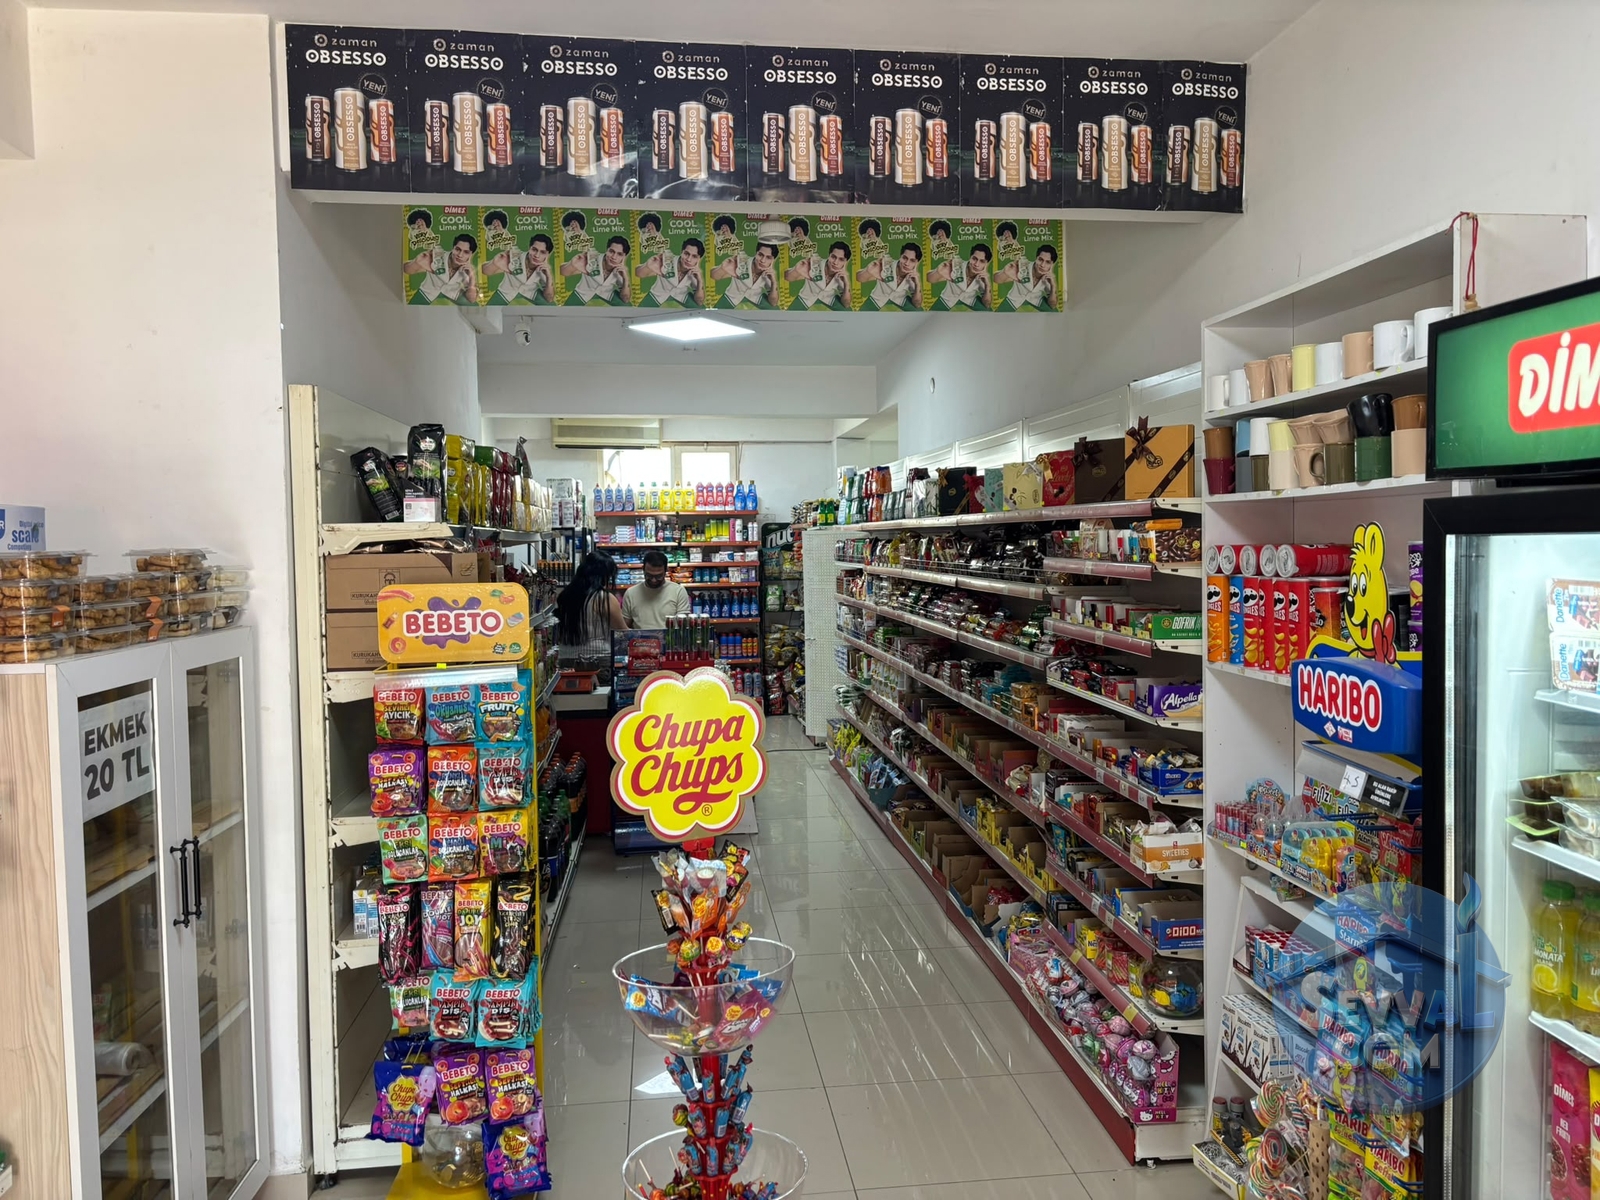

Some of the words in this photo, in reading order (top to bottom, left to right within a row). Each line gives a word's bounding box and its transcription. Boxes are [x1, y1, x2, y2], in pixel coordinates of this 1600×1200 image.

[332, 39, 377, 48] zaman
[450, 42, 494, 52] zaman
[305, 49, 386, 66] OBSESSO
[566, 48, 609, 58] zaman
[678, 54, 720, 63] zaman
[424, 54, 504, 70] OBSESSO
[541, 60, 618, 76] OBSESSO
[787, 58, 828, 66] zaman
[895, 61, 934, 71] zaman
[653, 65, 728, 80] OBSESSO
[763, 69, 836, 84] OBSESSO
[1000, 66, 1038, 74] zaman
[1102, 69, 1141, 78] zaman
[1196, 72, 1232, 82] zaman
[871, 73, 942, 88] OBSESSO
[977, 77, 1046, 92] OBSESSO
[1079, 80, 1148, 95] OBSESSO
[1172, 82, 1238, 99] OBSESSO
[345, 96, 354, 142] OBSESSO
[380, 105, 388, 141] OBSESSO
[432, 107, 440, 142] OBSESSO
[464, 100, 472, 145] OBSESSO
[577, 105, 586, 148] OBSESSO
[659, 115, 667, 150] OBSESSO
[689, 109, 697, 152] OBSESSO
[798, 112, 806, 156] OBSESSO
[1201, 124, 1210, 166] OBSESSO
[440, 216, 470, 224] COOL
[669, 219, 697, 227] COOL
[959, 226, 984, 234] COOL
[1518, 331, 1600, 417] DİM
[1555, 588, 1564, 622] Danette
[405, 611, 501, 633] BEBETO
[1559, 643, 1568, 679] Danette
[378, 693, 416, 701] BEBETO
[432, 691, 470, 702] BEBETO
[482, 692, 519, 701] BEBETO
[1163, 692, 1197, 709] Alpella
[1299, 667, 1377, 729] HARIBO
[480, 703, 519, 713] FRUITY
[84, 710, 148, 756] EKMEK
[634, 713, 745, 756] Chupa
[84, 757, 114, 801] 20
[121, 745, 150, 784] TL
[375, 764, 413, 774] BEBETO
[434, 762, 470, 771] BEBETO
[631, 752, 743, 815] Chups
[383, 828, 420, 839] BEBETO
[434, 828, 471, 838] BEBETO
[484, 823, 520, 834] BEBETO
[1162, 848, 1189, 857] SWEETIES
[379, 904, 409, 913] BEBETO
[1534, 948, 1563, 963] MONATA
[436, 988, 470, 998] BEBETO
[485, 989, 520, 998] BEBETO
[442, 1065, 478, 1080] BEBETO
[493, 1061, 528, 1075] BEBETO
[393, 1083, 416, 1094] Chupa
[390, 1093, 414, 1107] Chups
[1335, 1110, 1368, 1137] HARIB
[505, 1142, 526, 1155] Chups
